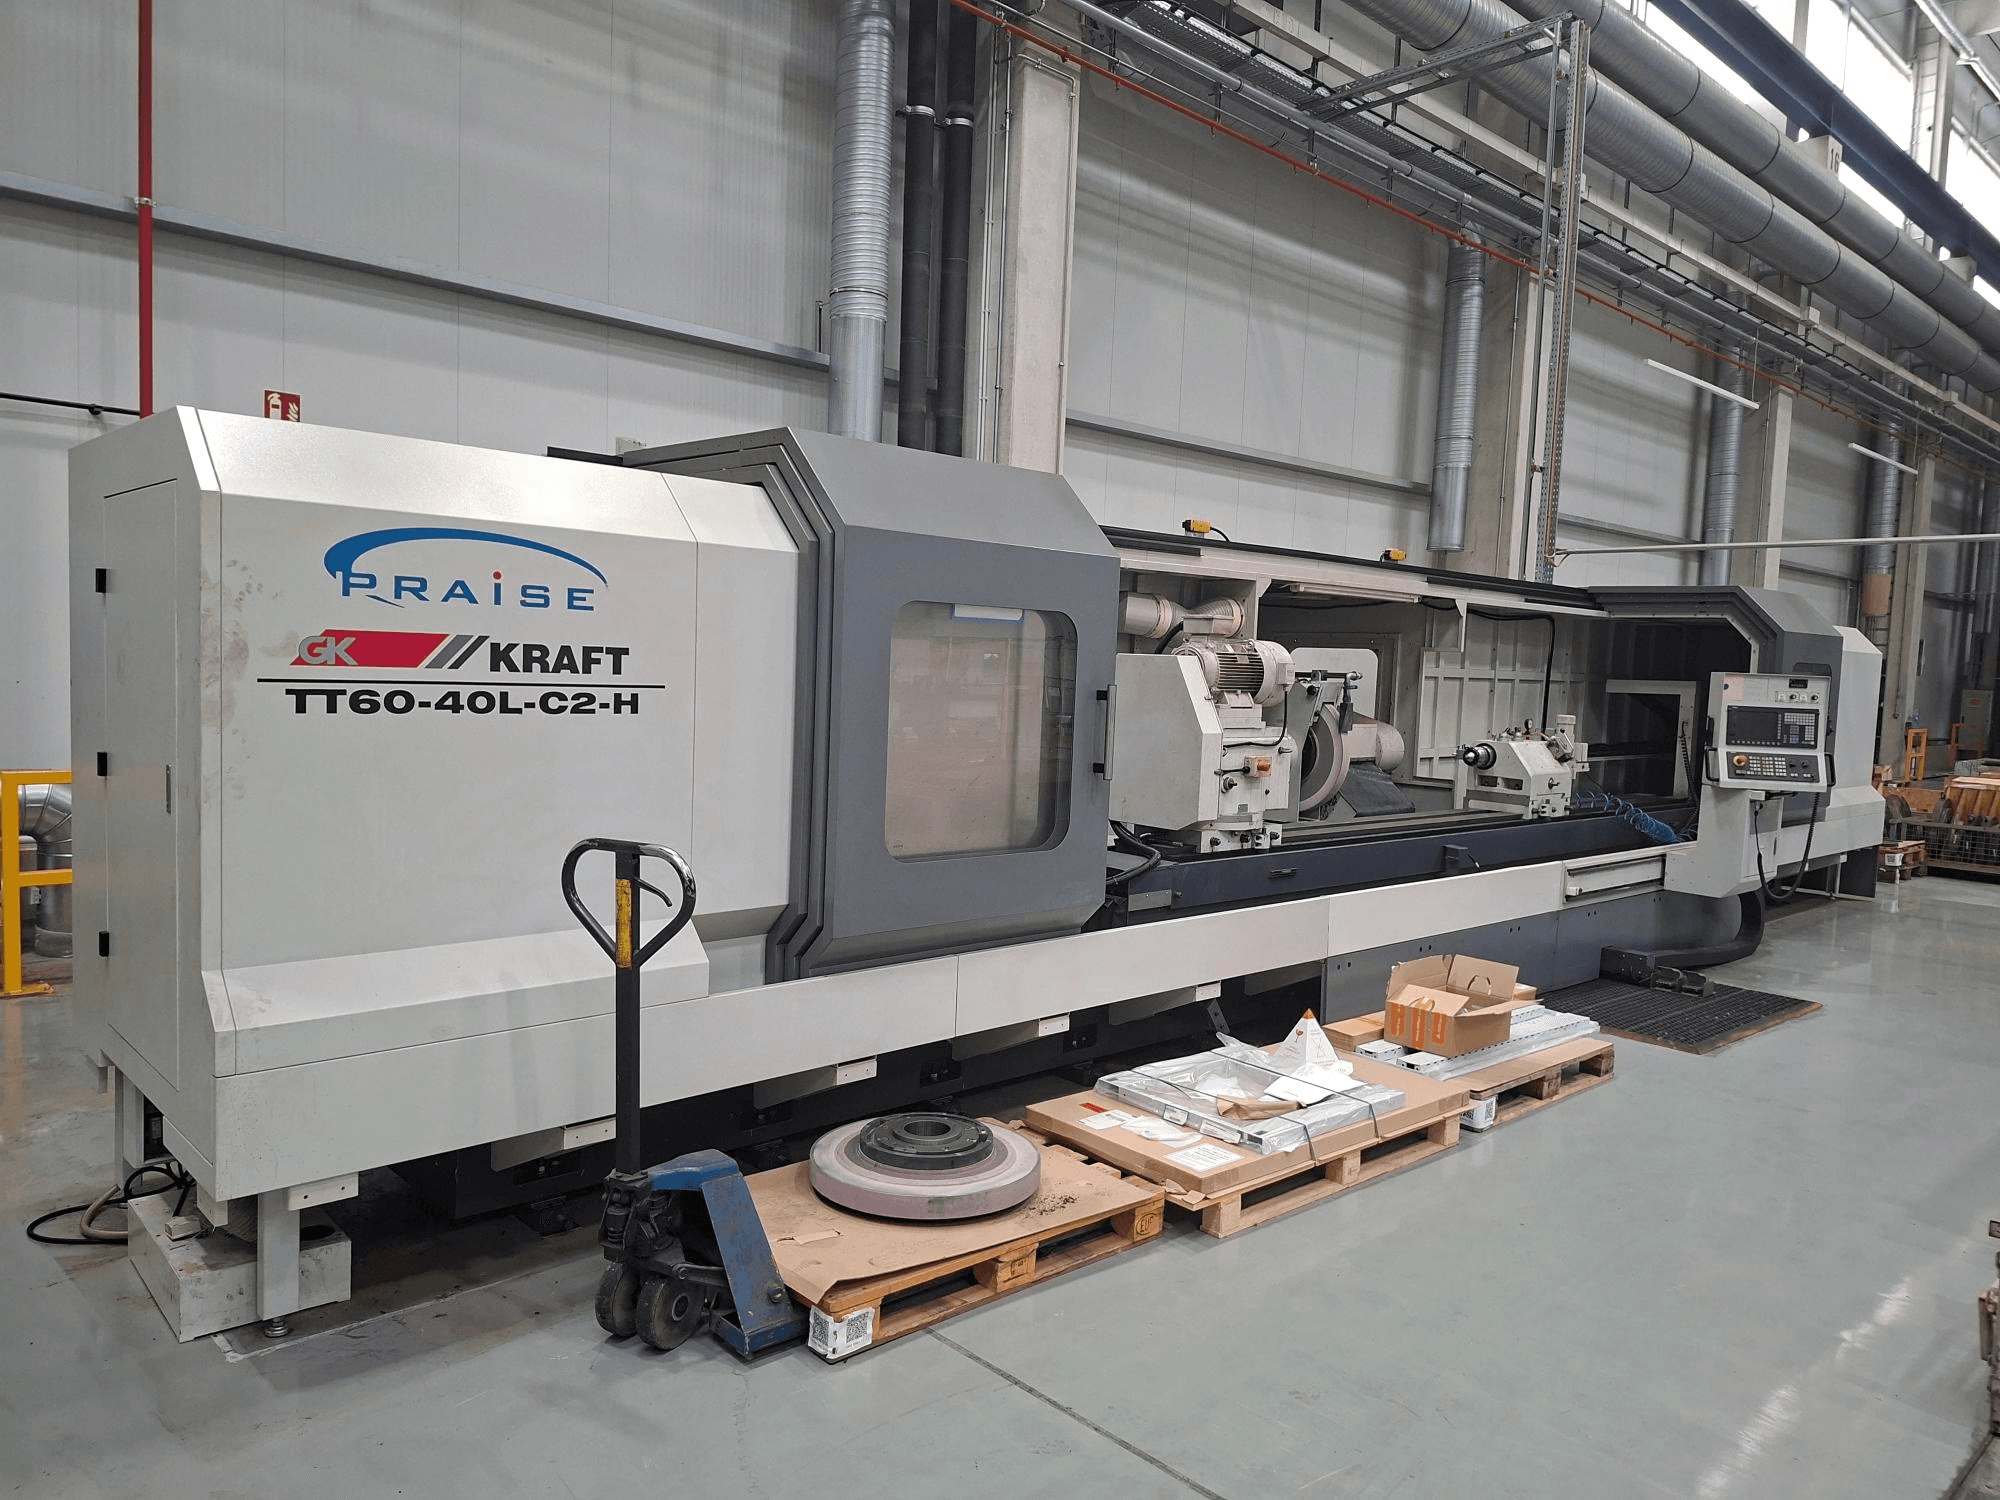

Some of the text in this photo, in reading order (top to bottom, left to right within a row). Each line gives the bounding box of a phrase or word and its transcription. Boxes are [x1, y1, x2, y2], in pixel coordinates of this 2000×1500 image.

[1830, 147, 1840, 174] 16
[298, 635, 630, 675] GK KRAFT
[285, 688, 640, 715] TT60-40L-C2-H
